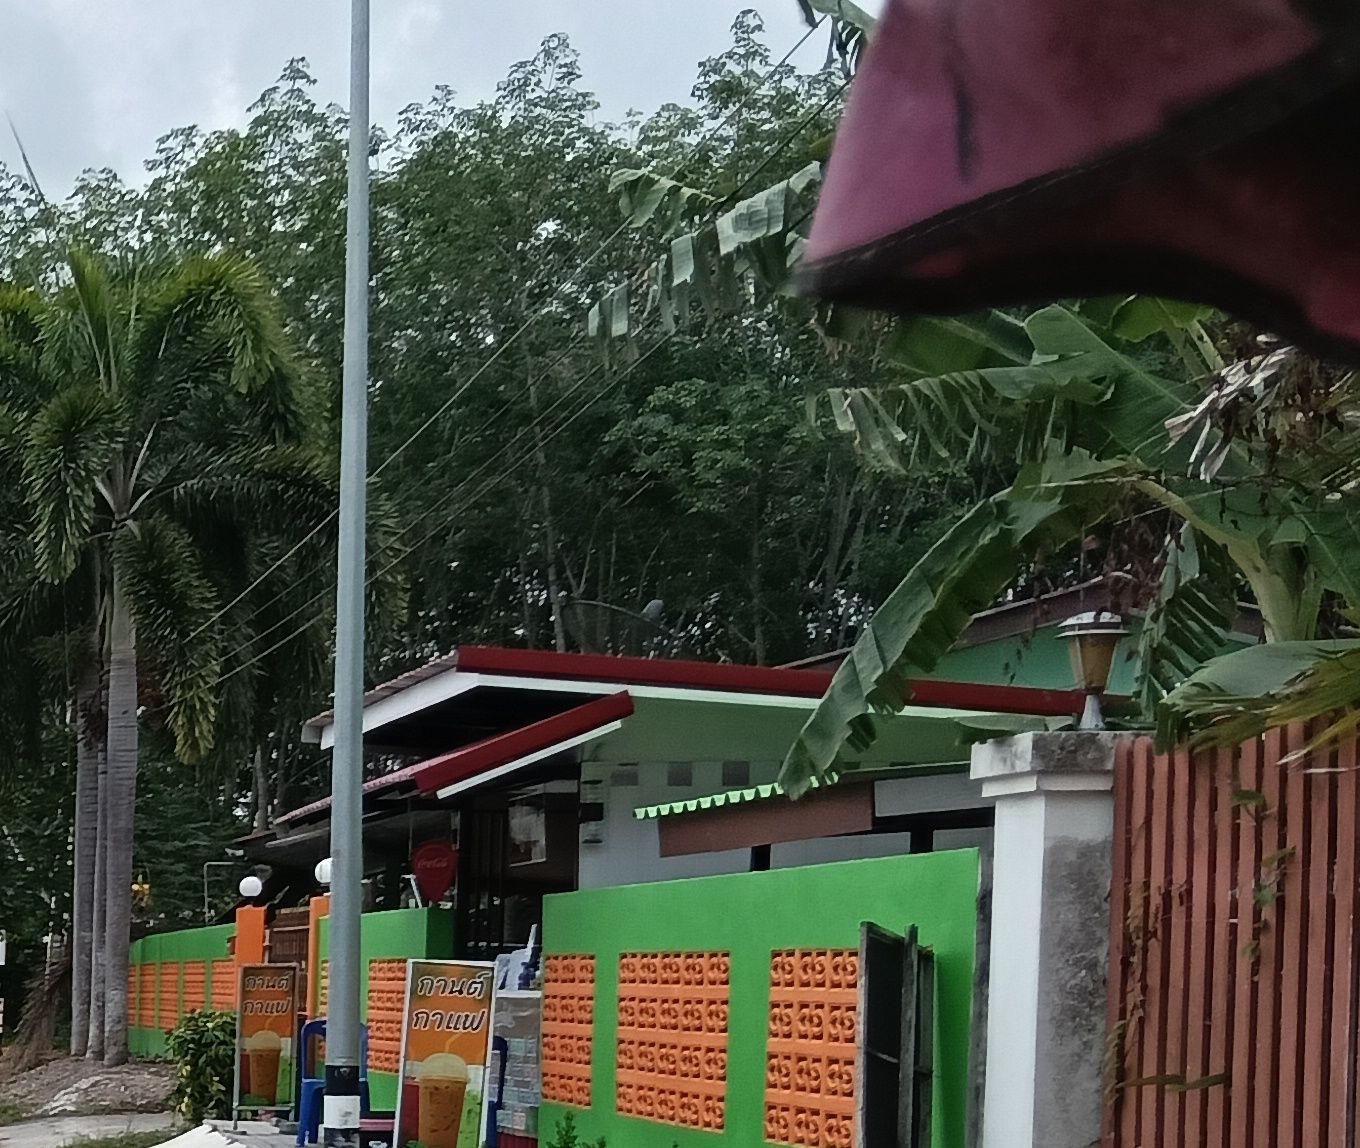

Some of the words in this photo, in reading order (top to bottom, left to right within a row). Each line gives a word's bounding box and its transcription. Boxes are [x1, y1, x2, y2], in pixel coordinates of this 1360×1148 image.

[417, 970, 492, 999] กานต์
[242, 996, 292, 1015] กาแฟ
[412, 1008, 488, 1033] กาแฟ
